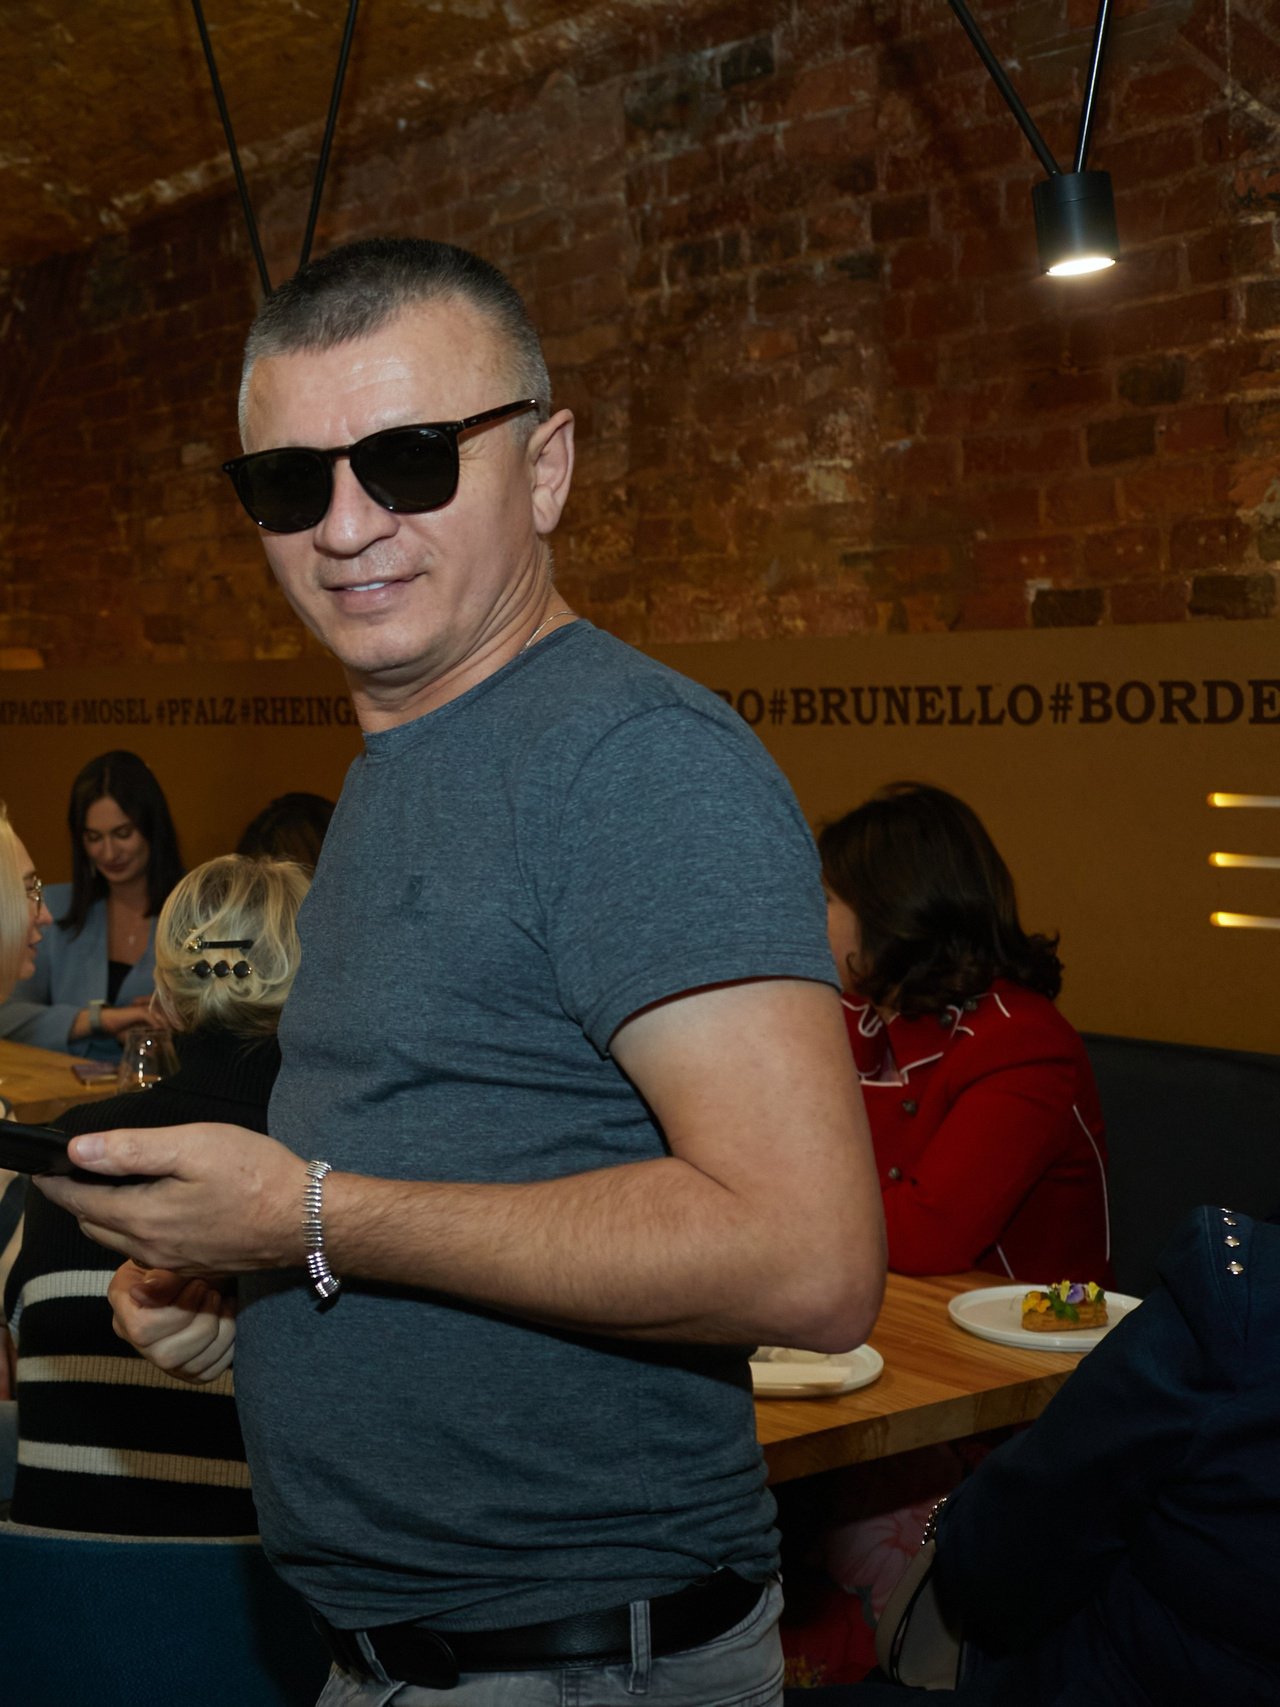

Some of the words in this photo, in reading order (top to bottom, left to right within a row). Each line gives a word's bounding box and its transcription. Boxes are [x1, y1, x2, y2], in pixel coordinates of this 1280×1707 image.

[73, 698, 150, 724] #MOSEL
[157, 697, 240, 725] #PFALZ
[242, 695, 359, 726] #RHEING
